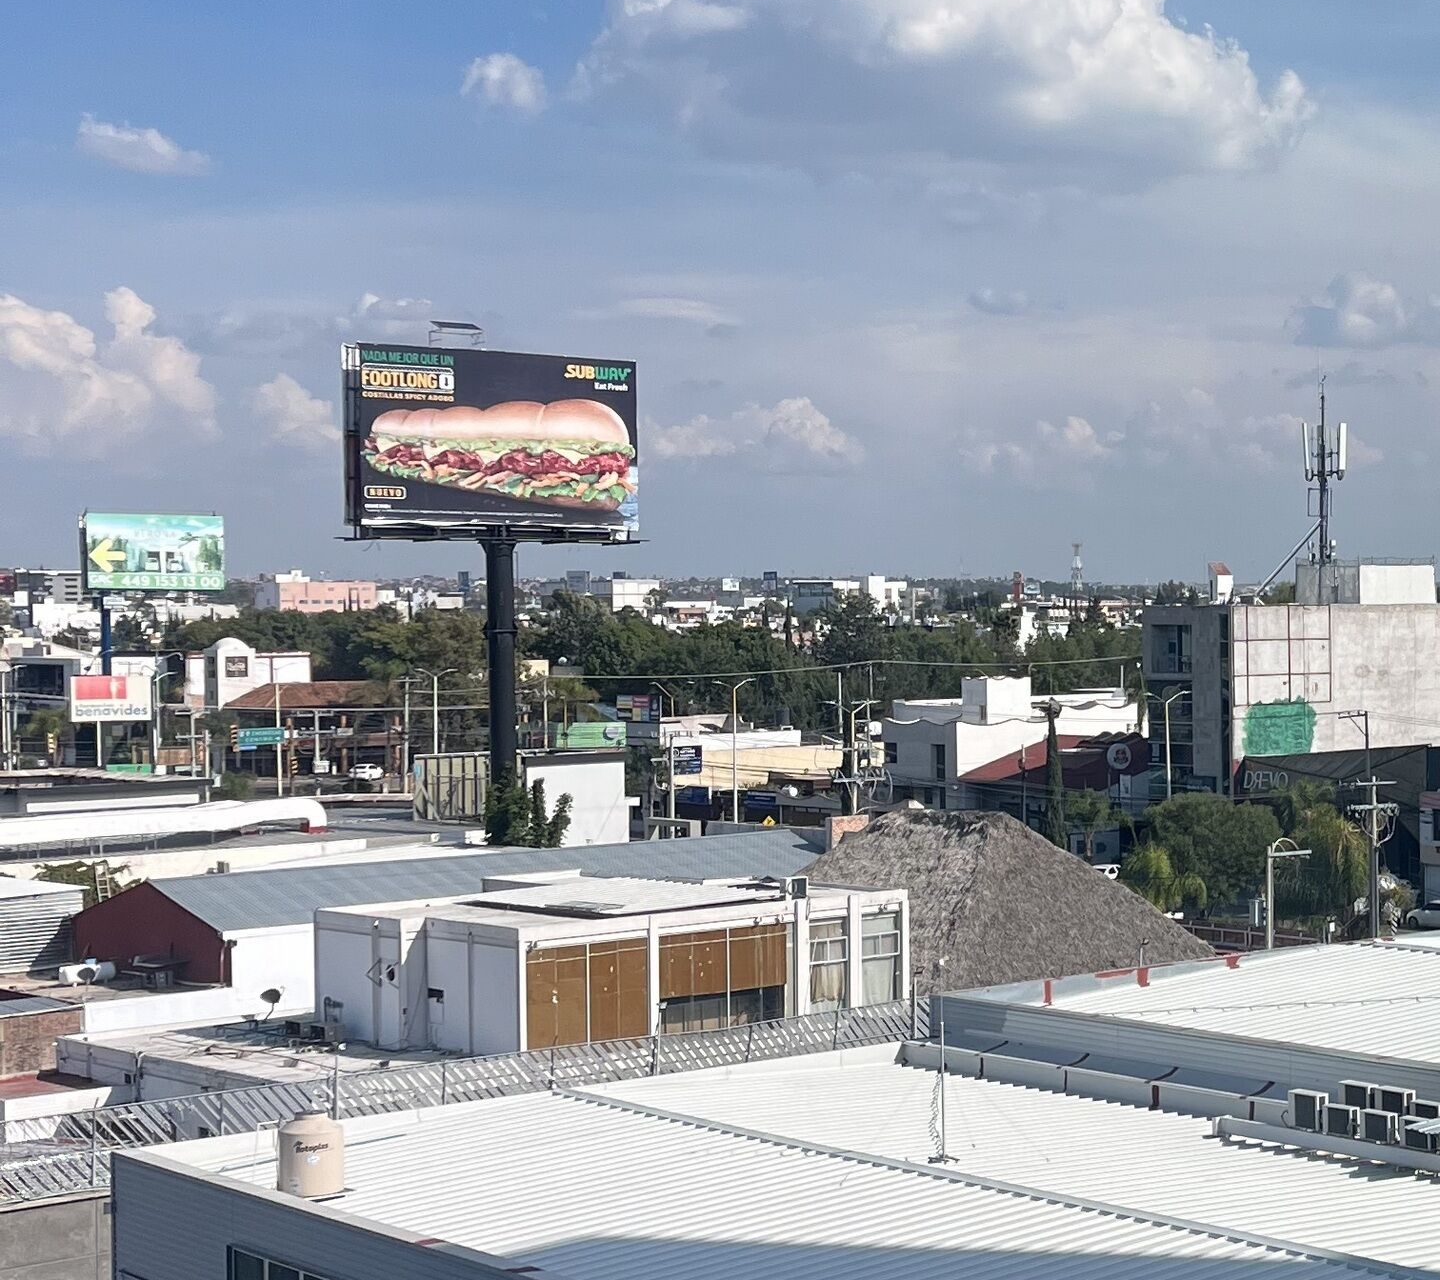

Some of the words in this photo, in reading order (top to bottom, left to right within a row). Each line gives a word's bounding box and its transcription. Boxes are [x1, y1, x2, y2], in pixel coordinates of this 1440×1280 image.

[361, 349, 388, 362] NADA
[388, 351, 420, 364] MEJOR
[420, 353, 438, 366] QUE
[440, 355, 454, 367] UN
[564, 364, 632, 381] SUBWAY
[361, 369, 438, 389] FOOTLONG
[594, 381, 607, 391] Eat
[607, 382, 629, 392] Fresh
[361, 390, 403, 400] COSTILLAS
[403, 392, 427, 401] SPICY
[369, 488, 403, 497] NUEVO
[121, 575, 150, 587] 449
[154, 575, 177, 587] 153
[182, 576, 196, 587] 13
[200, 577, 220, 588] 00
[75, 704, 148, 716] benavides
